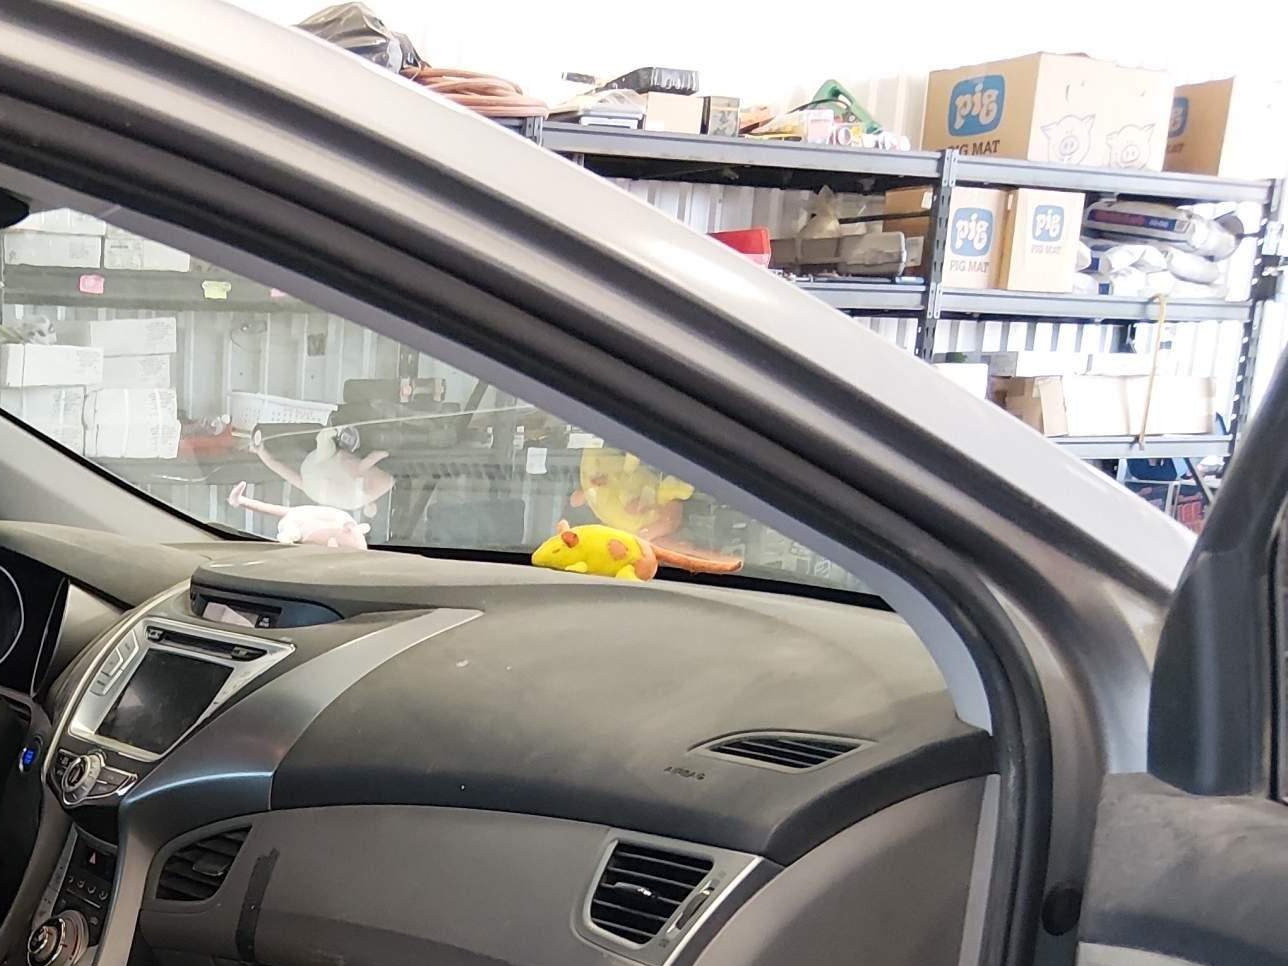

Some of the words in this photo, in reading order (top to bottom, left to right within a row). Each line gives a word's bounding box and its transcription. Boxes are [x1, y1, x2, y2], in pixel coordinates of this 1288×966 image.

[954, 81, 1000, 130] pig
[972, 139, 1001, 156] MAT
[955, 211, 990, 251] pig
[1034, 208, 1062, 238] pig
[950, 260, 967, 272] PIG
[967, 261, 991, 273] MAT
